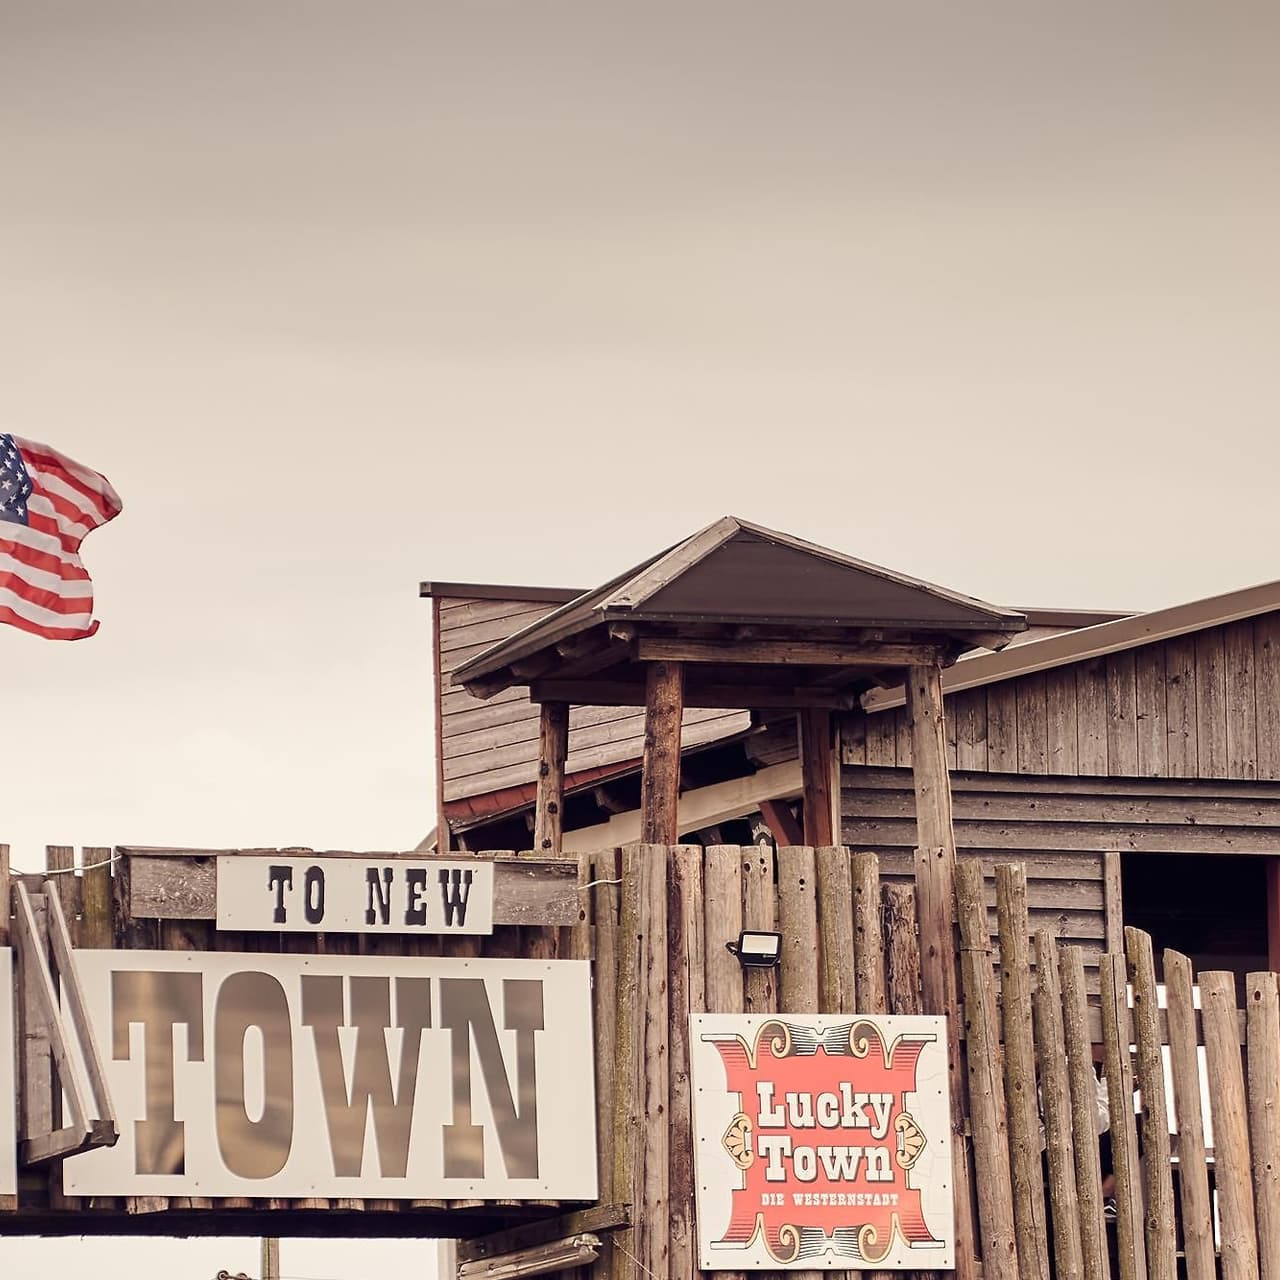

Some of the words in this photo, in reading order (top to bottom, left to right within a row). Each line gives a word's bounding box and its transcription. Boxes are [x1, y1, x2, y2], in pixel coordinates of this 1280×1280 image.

[268, 865, 325, 925] TO
[365, 867, 473, 927] NEW
[111, 970, 545, 1180] TOWN
[756, 1081, 895, 1140] Lucky
[756, 1135, 896, 1183] Town
[760, 1192, 785, 1207] DIE
[792, 1193, 900, 1207] WESTERNSTADT
